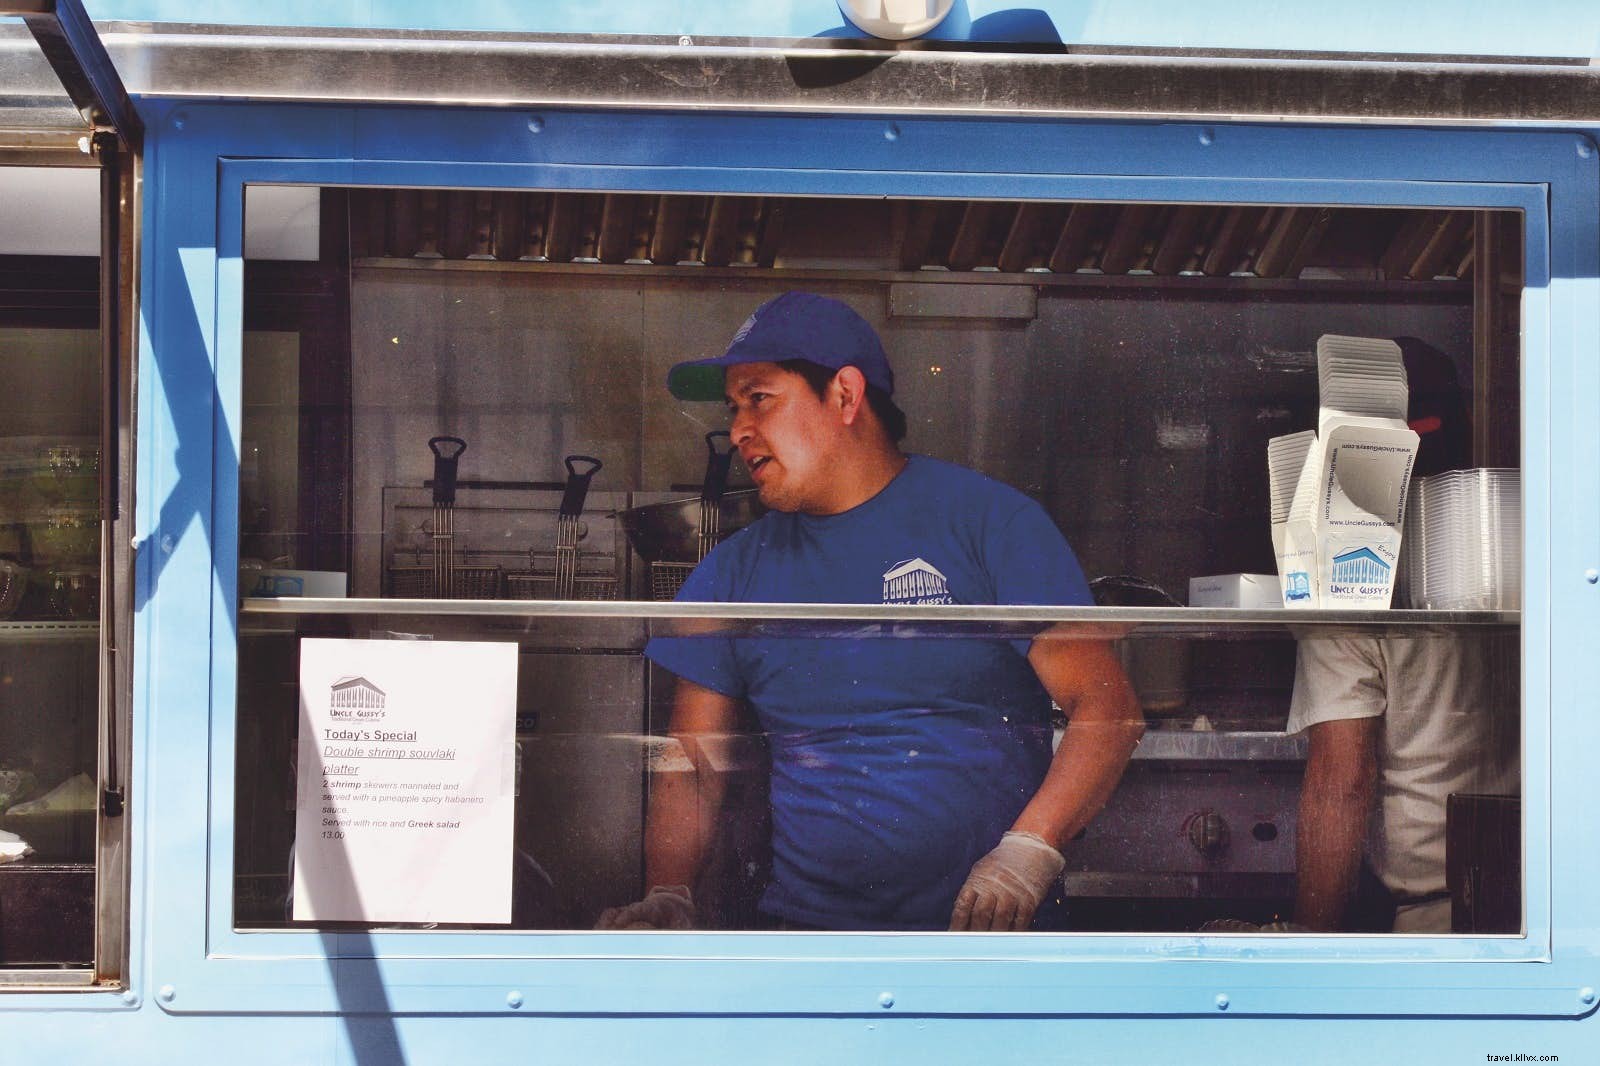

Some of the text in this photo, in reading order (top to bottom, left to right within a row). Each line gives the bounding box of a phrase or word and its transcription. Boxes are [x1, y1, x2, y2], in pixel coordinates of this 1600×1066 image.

[1377, 544, 1396, 561] Enjoy
[324, 729, 417, 742] Today's Special
[323, 746, 456, 760] Double shrimp souvlaki
[323, 764, 360, 776] platter
[322, 780, 328, 788] 2
[330, 780, 362, 790] shrimp
[363, 781, 398, 790] skewers
[443, 782, 459, 791] and
[322, 793, 351, 801] served
[353, 794, 369, 802] with
[378, 795, 420, 804] pineapple
[421, 795, 443, 805] spicy
[444, 795, 484, 804] habanero
[322, 818, 460, 829] Served with rice and Greek salad
[321, 831, 345, 840] 13.00
